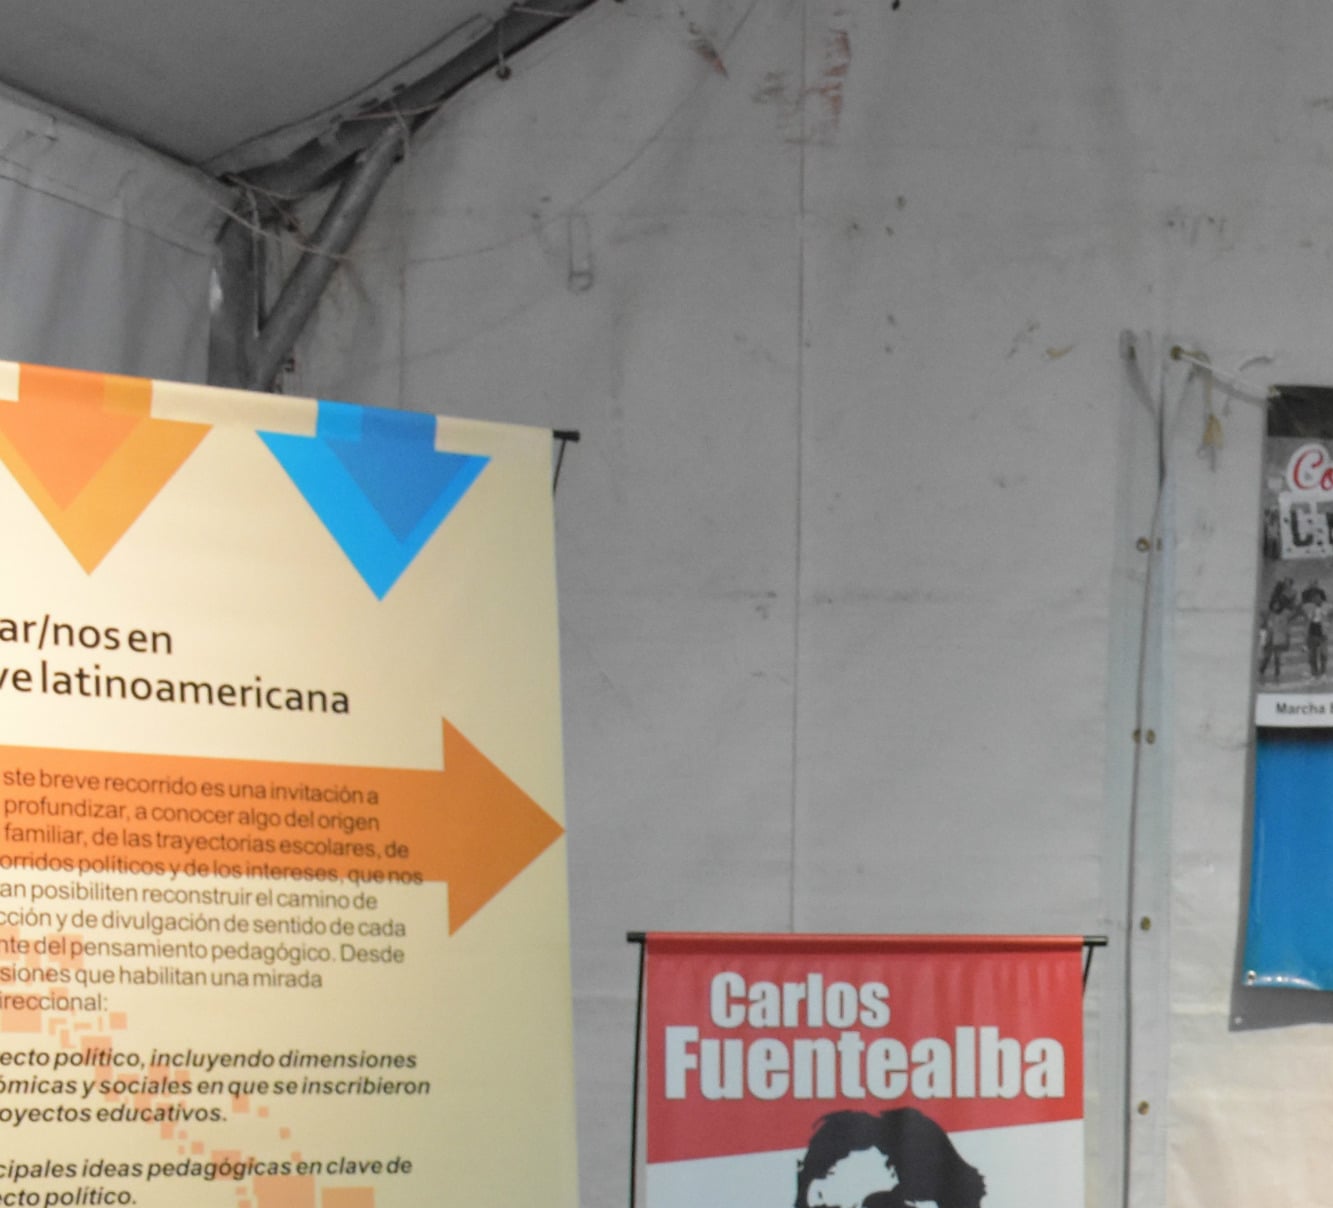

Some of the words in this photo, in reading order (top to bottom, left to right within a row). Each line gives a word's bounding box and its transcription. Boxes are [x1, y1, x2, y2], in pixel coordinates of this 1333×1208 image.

[129, 630, 172, 654] en
[41, 661, 350, 714] latinoamericana
[1275, 702, 1327, 715] Marcha
[0, 883, 26, 898] an
[31, 882, 138, 906] posibiliten
[142, 886, 252, 906] reconstruir
[256, 888, 273, 906] el
[277, 889, 350, 910] camino
[353, 891, 379, 910] de
[34, 936, 66, 956] del
[70, 938, 208, 963] pensamiento
[211, 942, 336, 966] pedagógico.
[340, 944, 405, 964] Desde
[75, 967, 115, 987] que
[119, 965, 207, 987] habilitan
[211, 971, 248, 988] una
[253, 970, 323, 989] mirada
[711, 971, 890, 1028] Carlos
[53, 1048, 146, 1072] político,
[150, 1048, 275, 1073] incluyendo
[279, 1049, 417, 1069] dimensiones
[665, 1025, 1065, 1099] Fuentealba
[96, 1103, 227, 1123] educativos.
[82, 1159, 143, 1178] ideas
[147, 1157, 292, 1181] pedagógicas
[296, 1160, 322, 1175] en
[327, 1156, 383, 1175] clave
[387, 1156, 413, 1174] de
